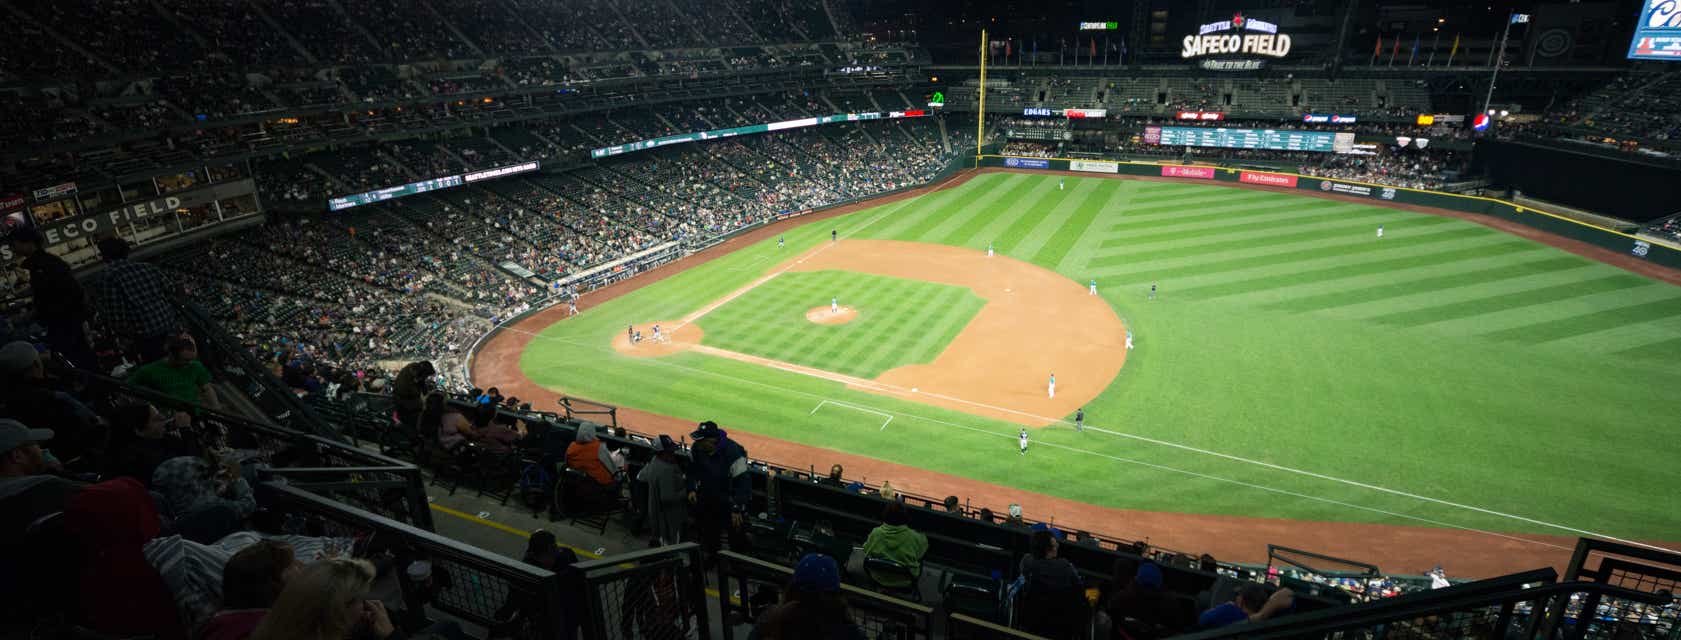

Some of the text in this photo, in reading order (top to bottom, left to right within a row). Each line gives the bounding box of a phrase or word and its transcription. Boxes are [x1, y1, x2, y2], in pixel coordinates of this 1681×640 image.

[1181, 33, 1292, 58] SAFECO FIELD
[1247, 174, 1289, 184] Fly Emirates
[109, 196, 181, 225] FIELD
